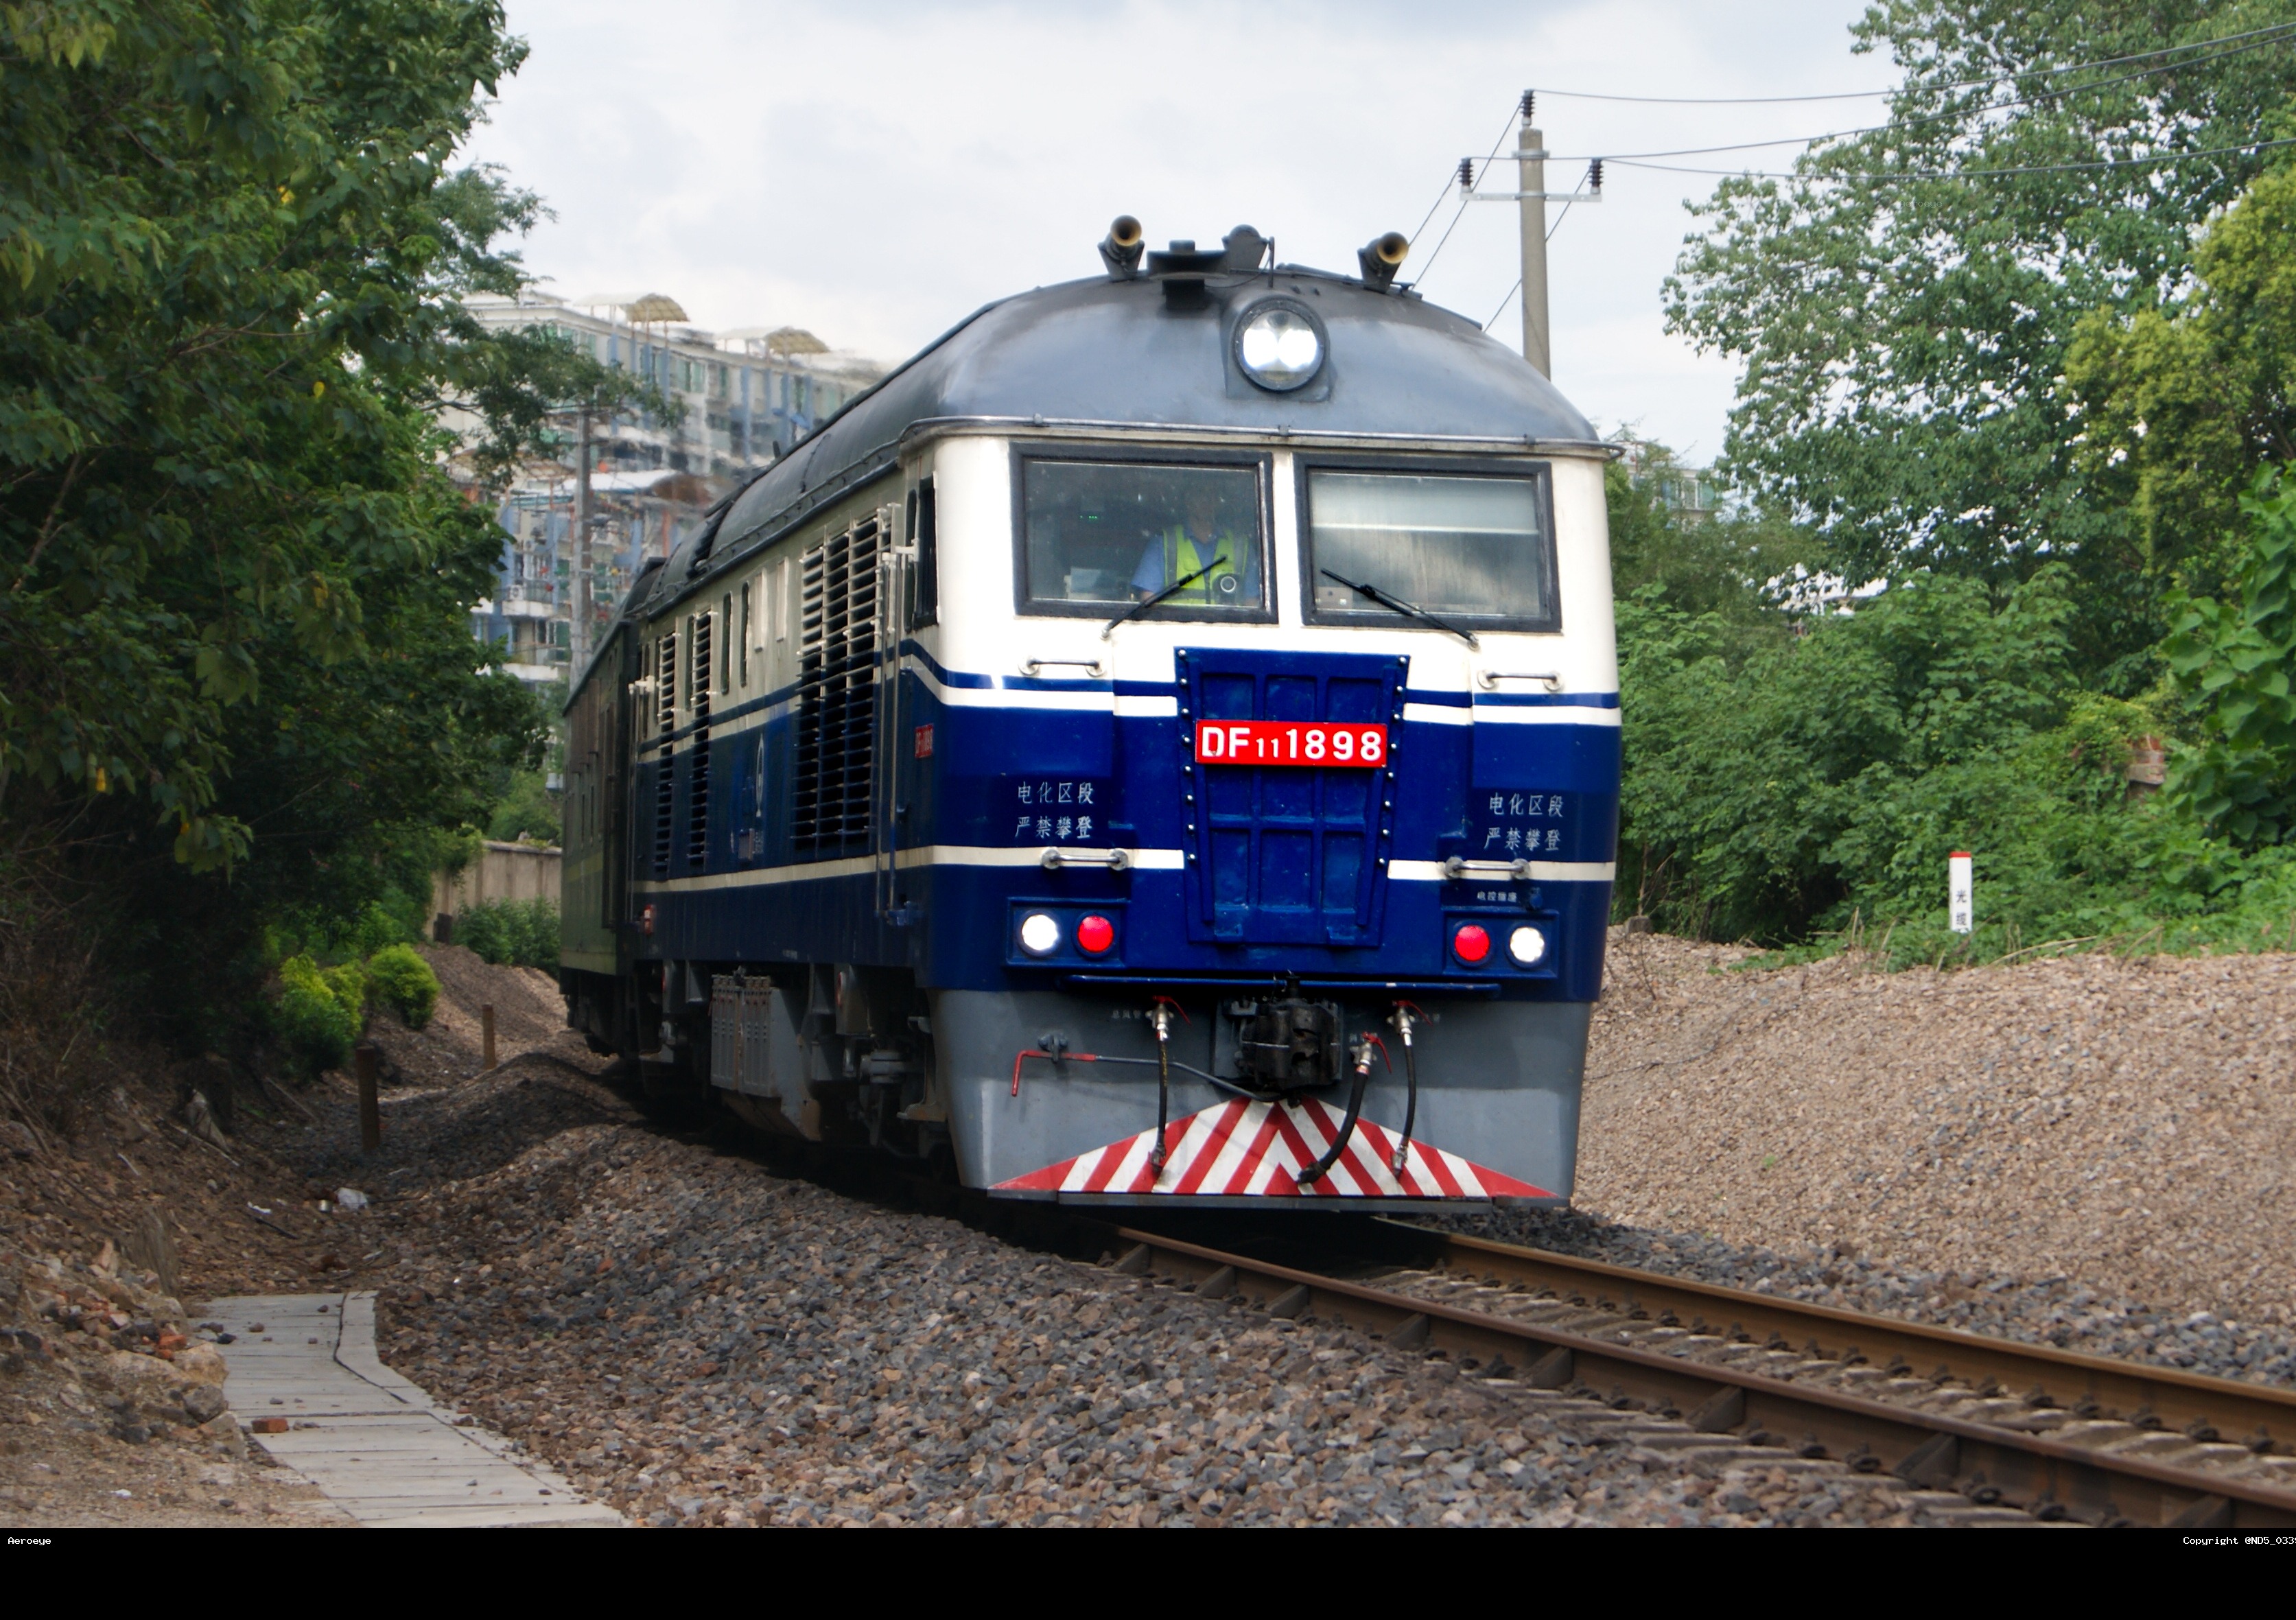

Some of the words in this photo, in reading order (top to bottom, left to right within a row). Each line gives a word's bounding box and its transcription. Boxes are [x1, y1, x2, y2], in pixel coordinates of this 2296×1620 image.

[1018, 781, 1093, 804] 电化区段
[1489, 792, 1563, 817] 电化区段
[1015, 815, 1092, 839] 严禁攀登
[1484, 827, 1560, 852] 严禁攀登
